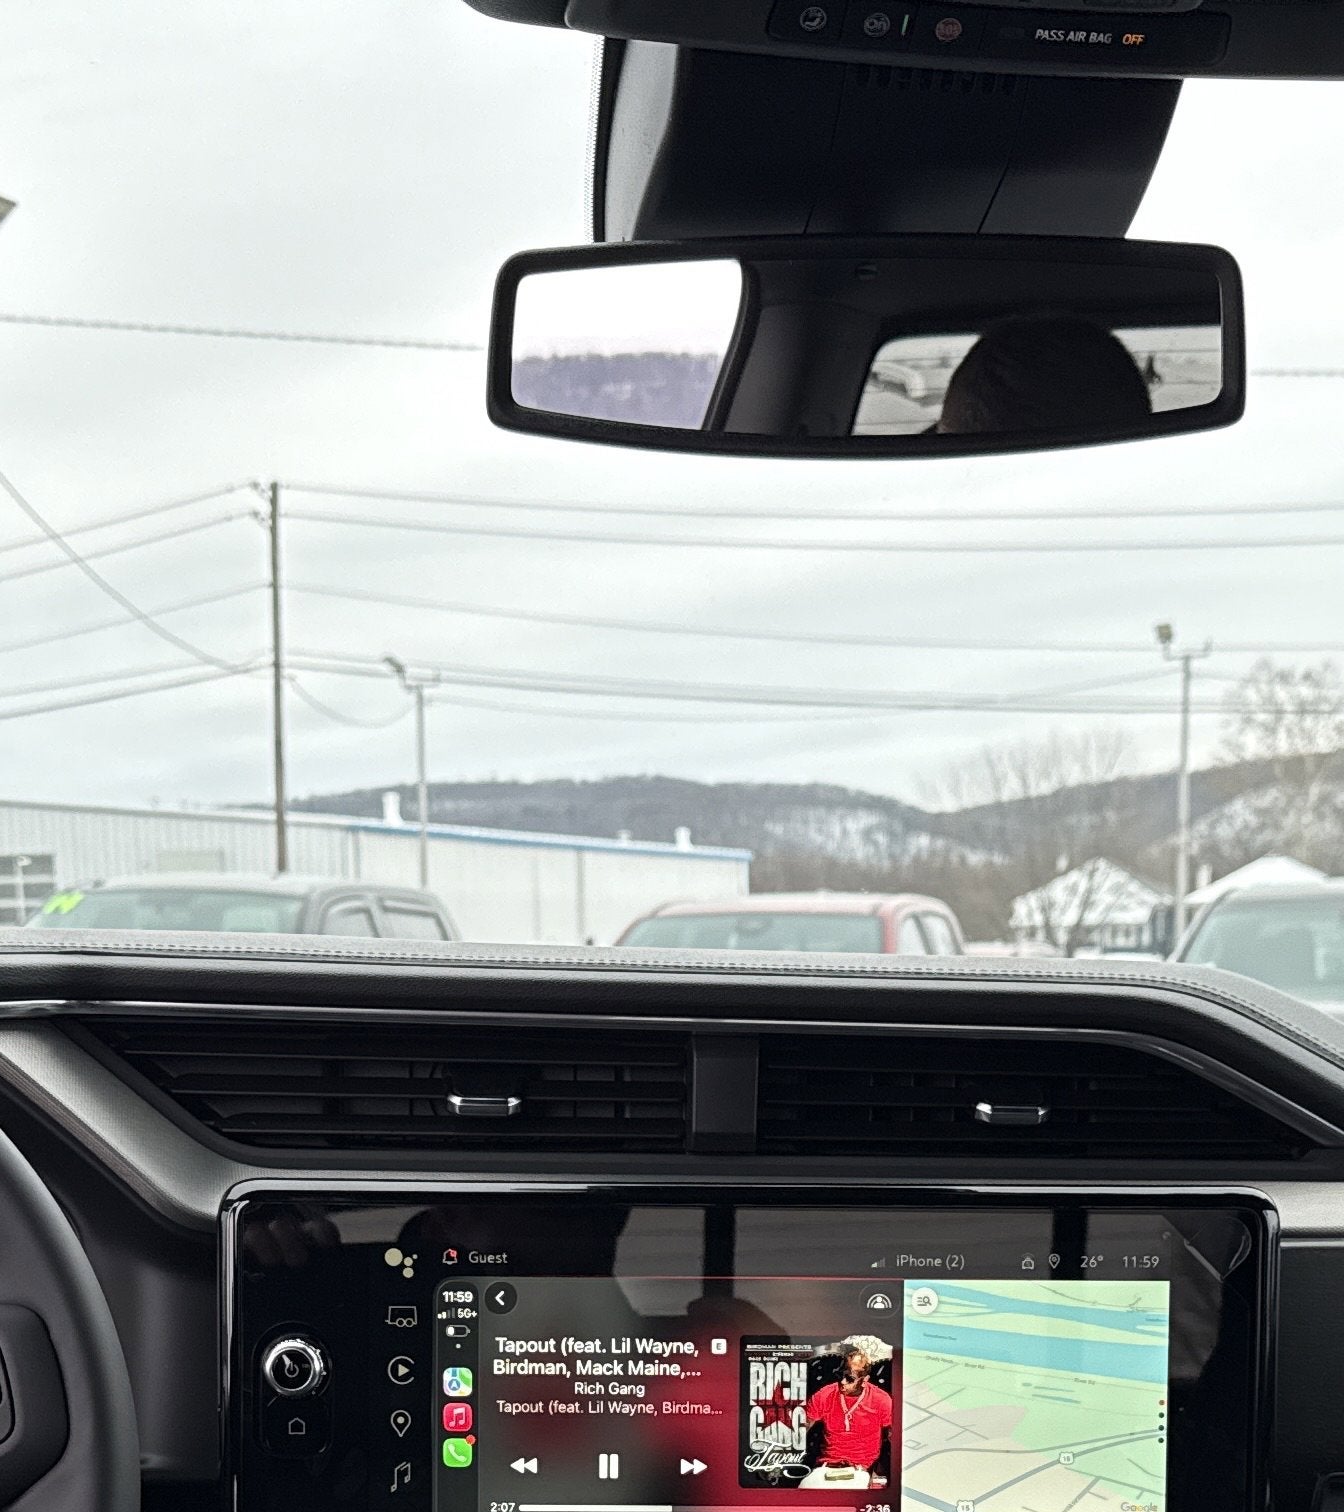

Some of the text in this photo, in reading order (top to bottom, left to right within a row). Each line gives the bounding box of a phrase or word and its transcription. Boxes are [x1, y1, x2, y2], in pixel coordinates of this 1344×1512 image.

[1034, 28, 1145, 46] PASS AIR BAG OFF
[468, 1250, 508, 1264] Guest
[896, 1254, 965, 1270] iPhone (2)
[1080, 1254, 1104, 1269] 26°
[1122, 1255, 1160, 1269] 11:59
[442, 1290, 473, 1303] 11:59
[457, 1308, 478, 1319] 5G+
[495, 1337, 699, 1358] Tapout (feat. Lil Wayne,
[493, 1359, 571, 1378] Birdman,
[576, 1360, 623, 1376] Mack
[574, 1381, 646, 1398] Rich Gang
[749, 1361, 808, 1401] RICH
[496, 1400, 544, 1416] Tapout
[548, 1400, 585, 1416] (feat.
[588, 1400, 606, 1414] Lil
[608, 1401, 658, 1417] Wayne,
[749, 1405, 807, 1450] GANG
